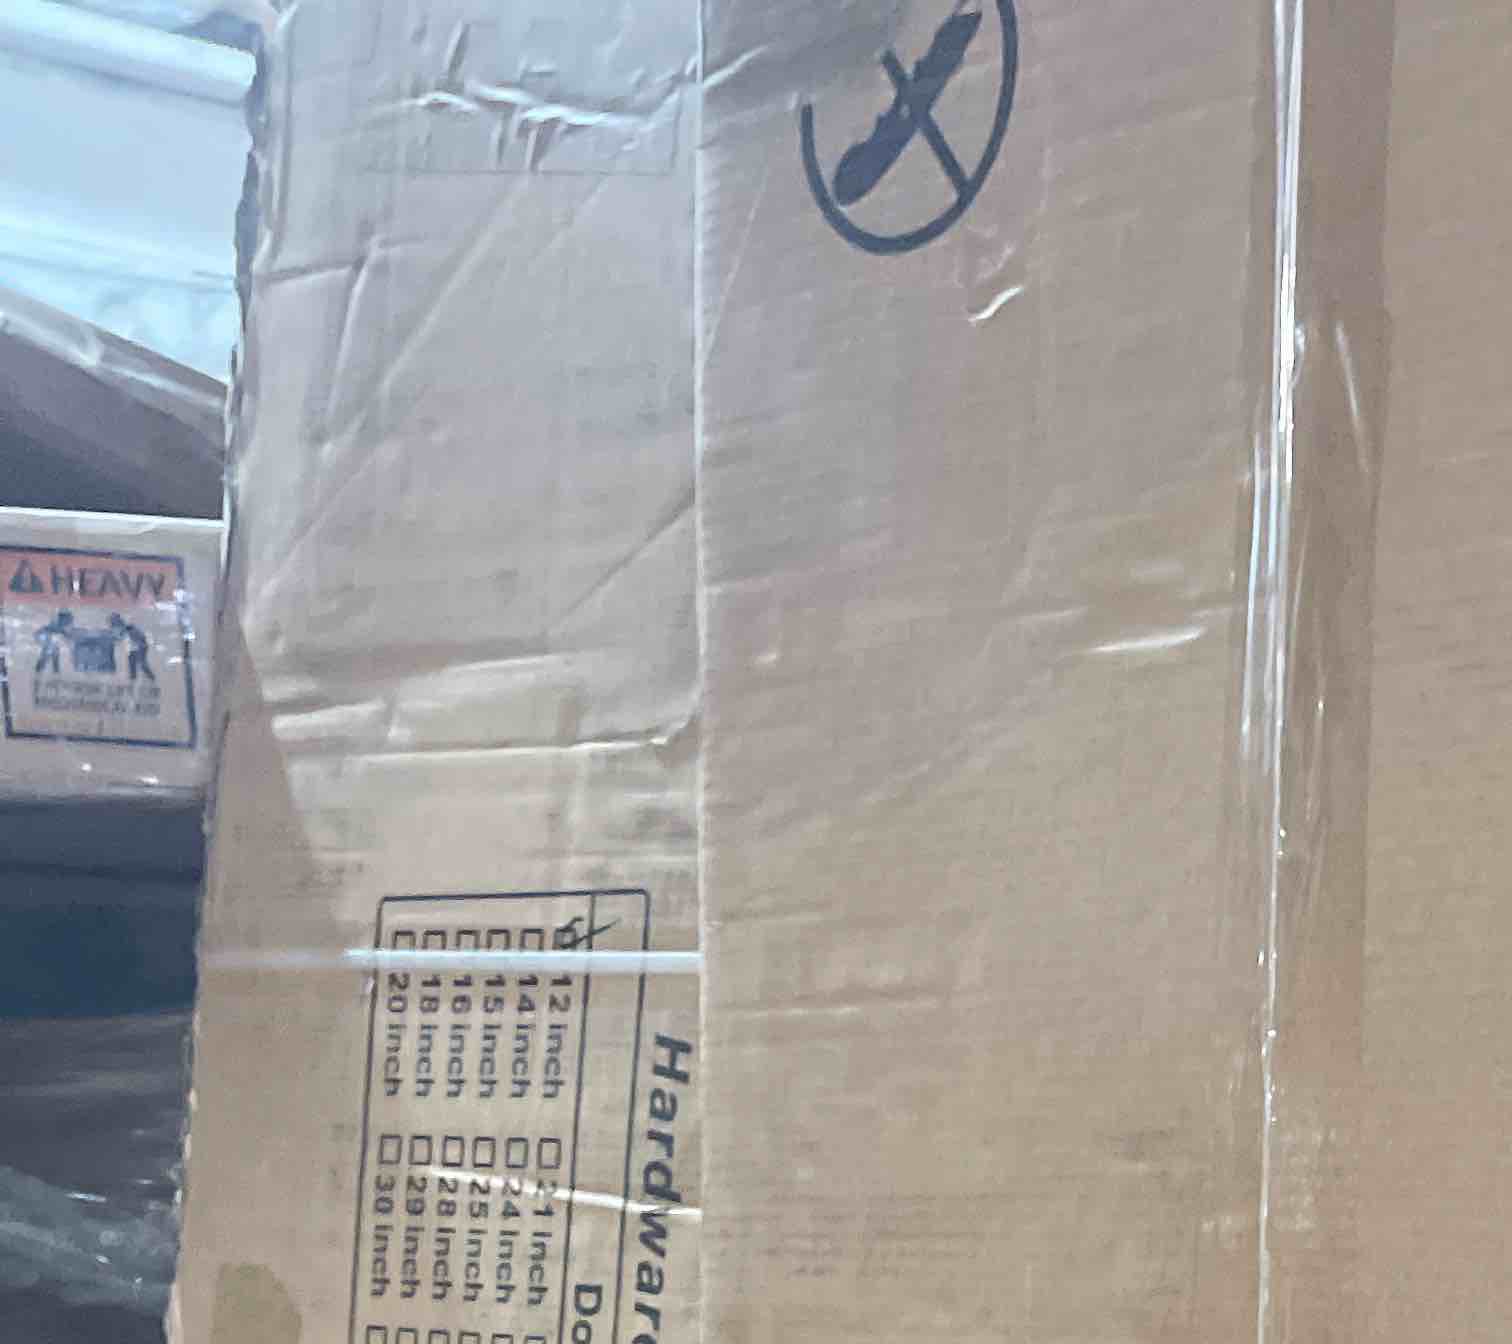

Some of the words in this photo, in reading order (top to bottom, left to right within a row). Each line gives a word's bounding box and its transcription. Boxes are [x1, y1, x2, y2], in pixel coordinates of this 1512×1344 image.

[50, 565, 165, 598] HEAVY
[386, 972, 411, 1014] 20
[419, 973, 442, 1014] 18
[451, 973, 473, 1014] 16
[484, 973, 507, 1014] 15
[517, 973, 540, 1014] 14
[548, 973, 572, 1014] 12
[375, 1174, 395, 1214] 30
[406, 1176, 427, 1216] 29
[438, 1177, 458, 1217] 28
[469, 1179, 491, 1218] 25
[500, 1177, 523, 1219] 24
